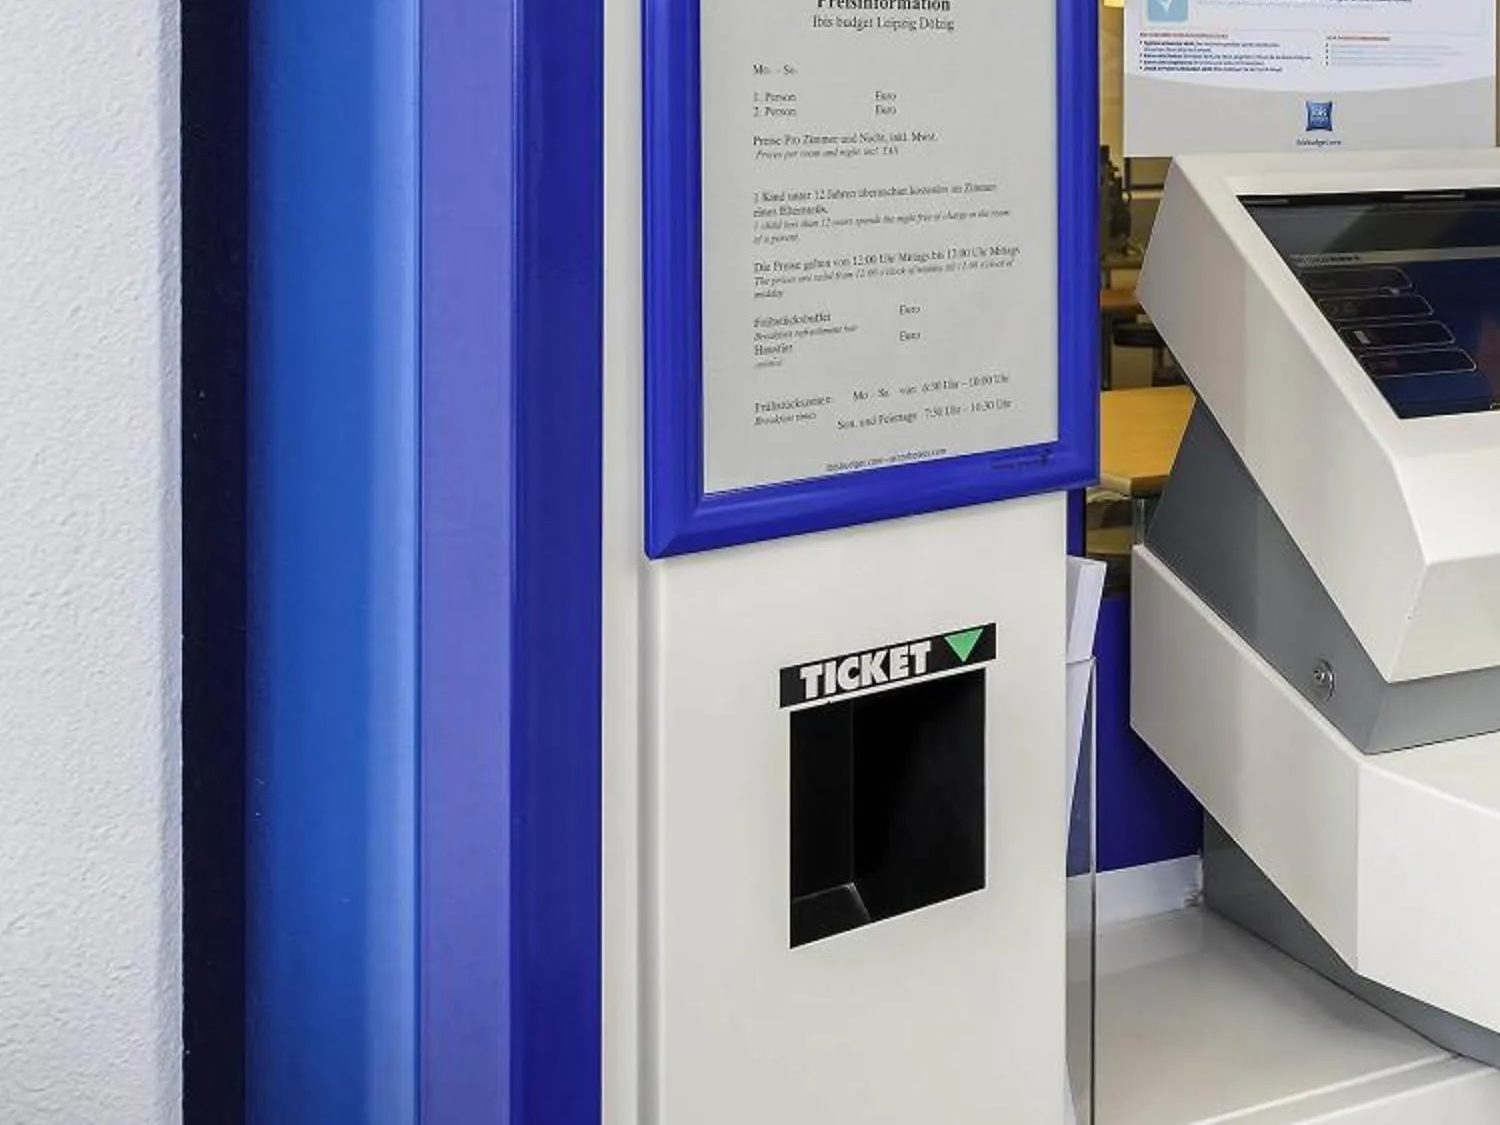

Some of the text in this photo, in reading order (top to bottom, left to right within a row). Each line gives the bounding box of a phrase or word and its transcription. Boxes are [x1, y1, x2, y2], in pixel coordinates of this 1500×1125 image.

[812, 14, 834, 29] Ibis
[835, 15, 874, 32] budget
[800, 640, 932, 700] TICKET
